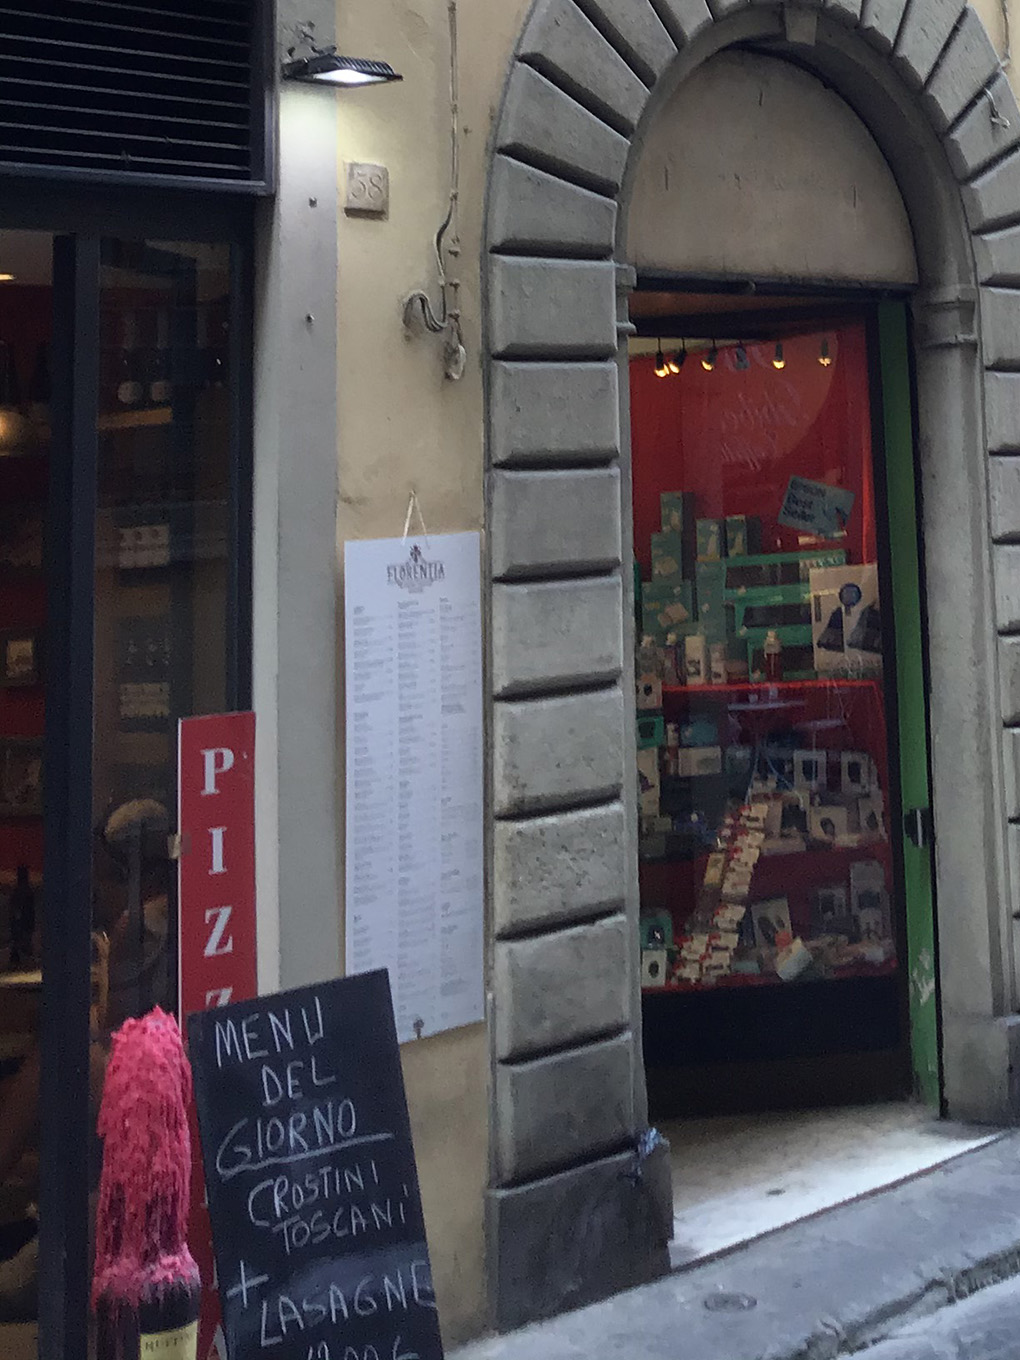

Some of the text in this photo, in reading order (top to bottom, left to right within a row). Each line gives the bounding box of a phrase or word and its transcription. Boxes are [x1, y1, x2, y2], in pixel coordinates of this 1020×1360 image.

[350, 171, 384, 202] 58
[386, 560, 446, 585] FLORENTIA
[214, 996, 324, 1068] MENU
[261, 1056, 336, 1107] DEL
[216, 1098, 357, 1176] GIORNO
[249, 1160, 379, 1227] CROSTINI
[260, 1259, 438, 1347] LASAGNE
